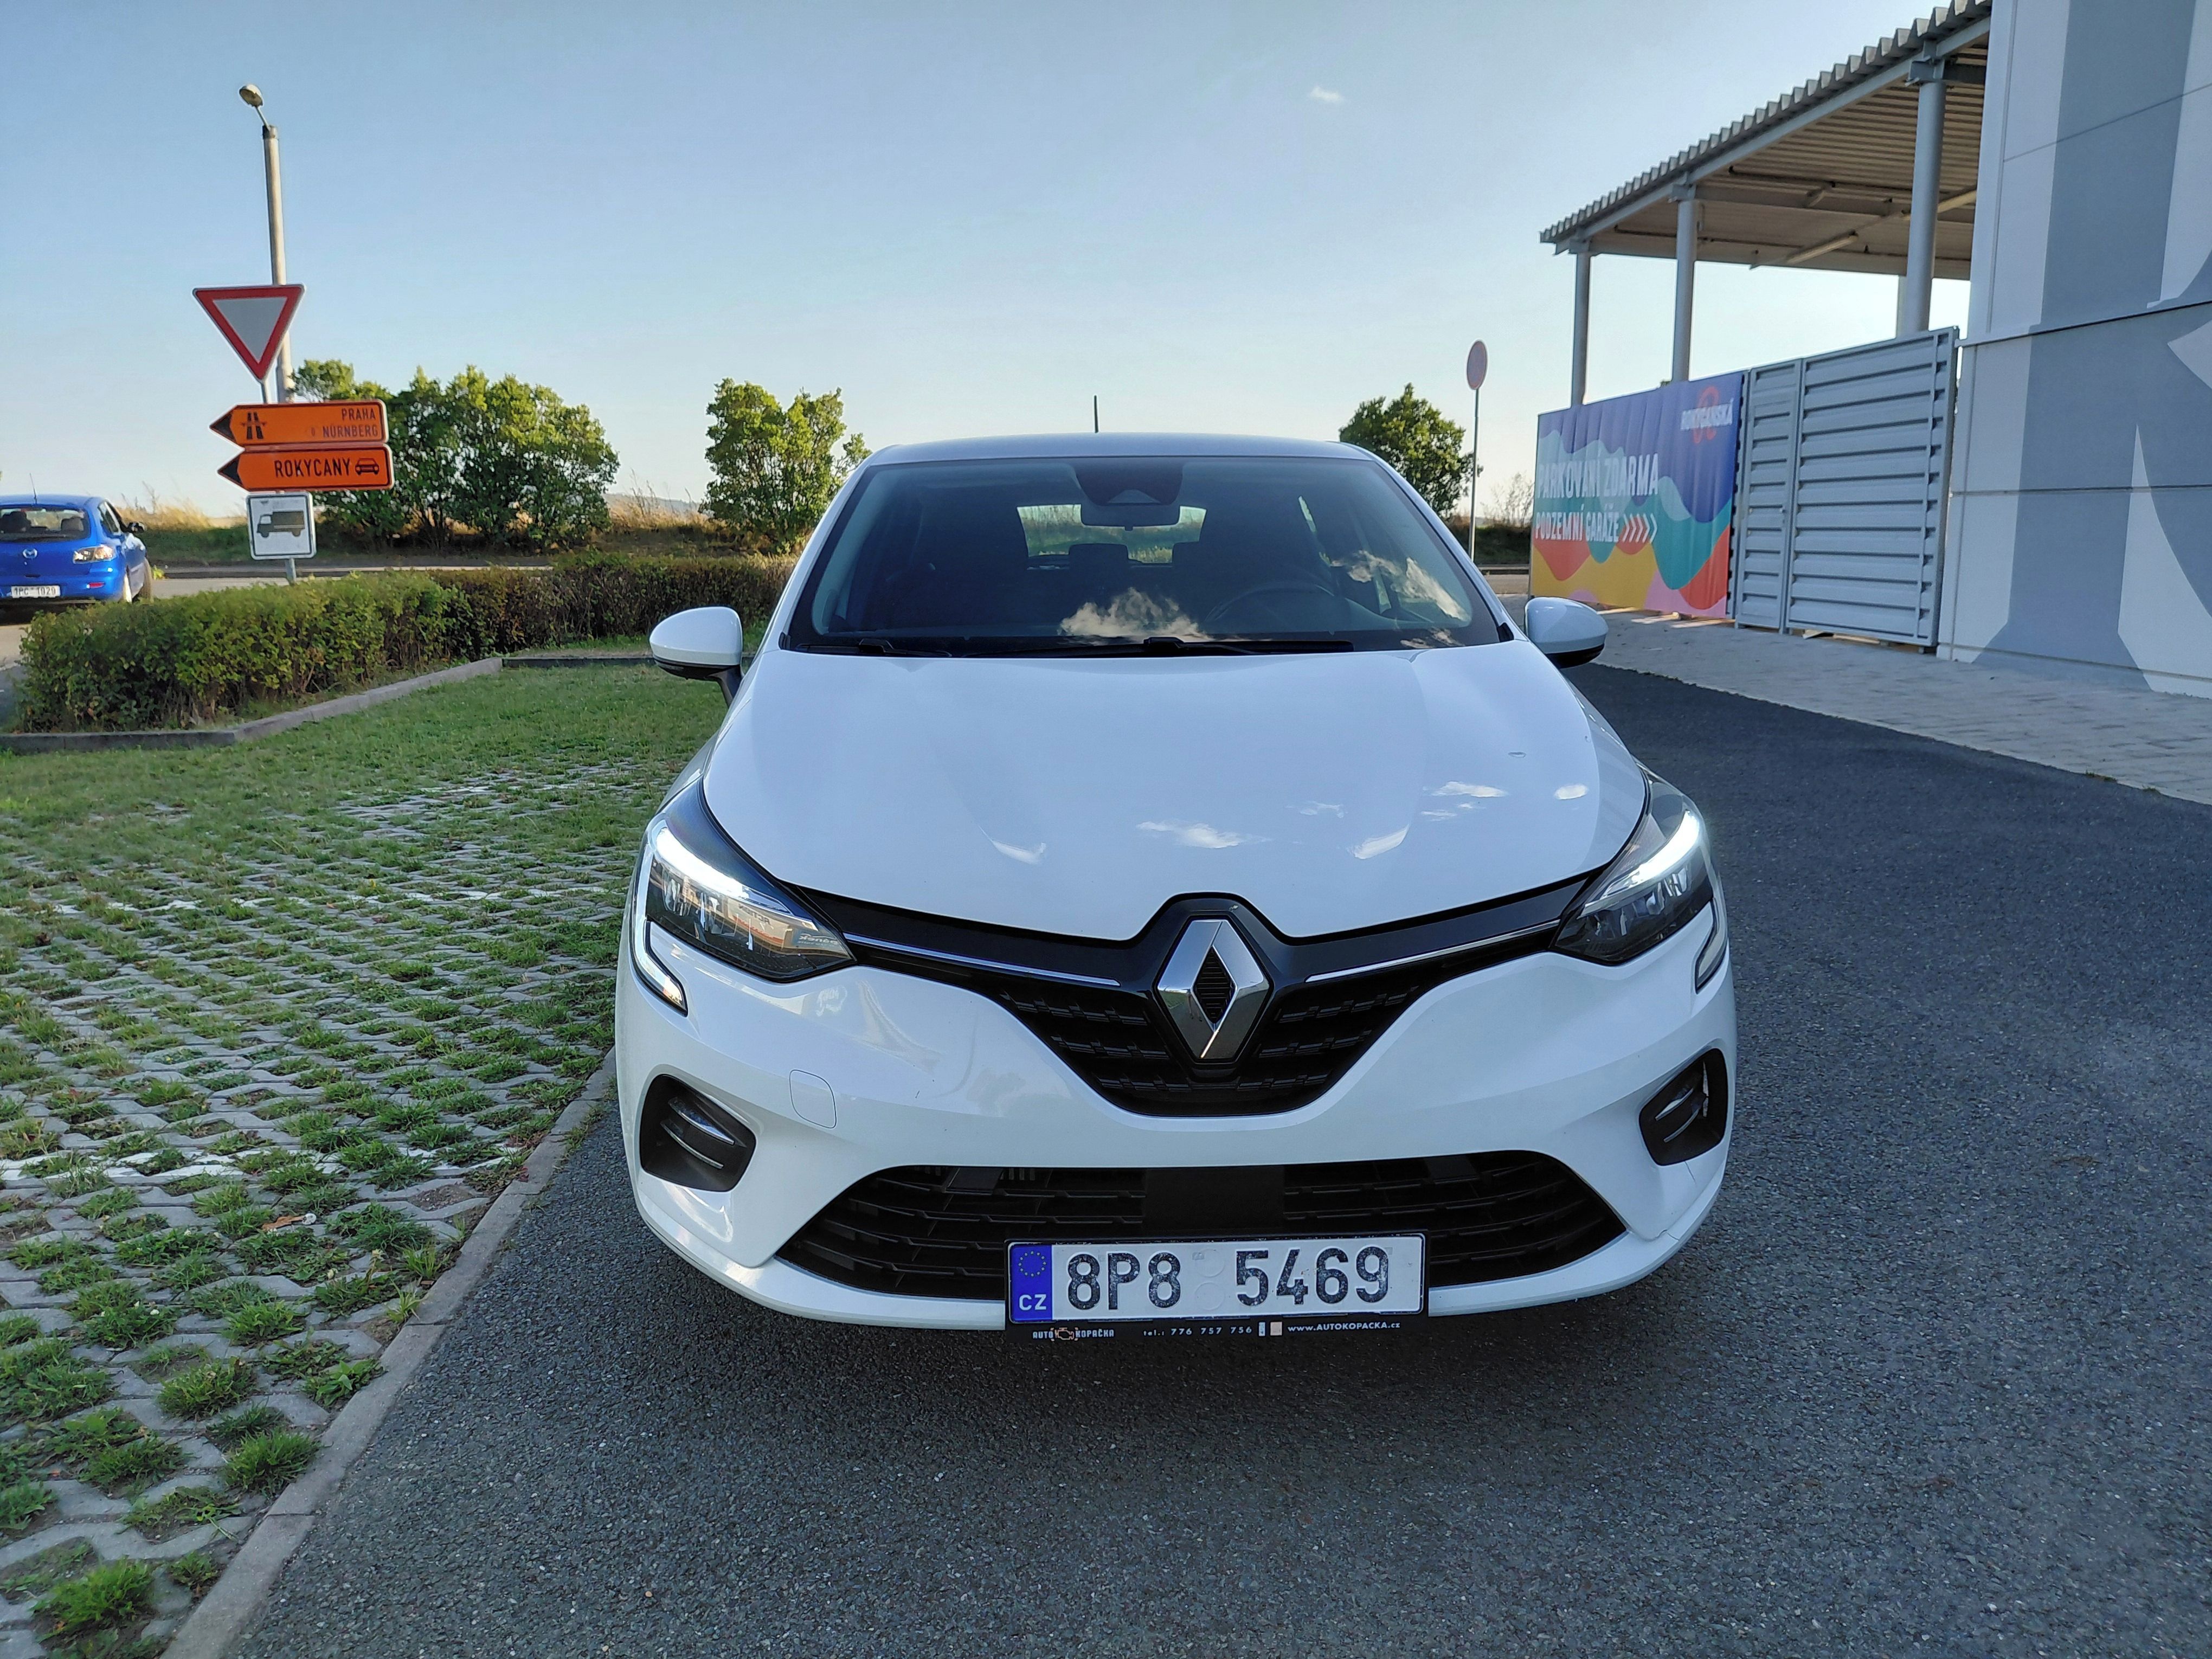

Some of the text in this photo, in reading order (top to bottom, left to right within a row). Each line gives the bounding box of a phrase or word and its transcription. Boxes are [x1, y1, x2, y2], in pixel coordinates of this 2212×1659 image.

[341, 407, 376, 421] PRAHA
[274, 457, 350, 478] ROKYCANY
[1603, 453, 1659, 497] ZDARMA
[1535, 503, 1619, 542] PODZEMNÍ GARÁŽE
[1067, 1245, 1389, 1310] 8P8 5469
[1019, 1294, 1047, 1311] CZ
[1033, 1328, 1114, 1339] AUTO KOPAČKA
[1288, 1322, 1400, 1332] www.AUTOKOPACKA.cz
